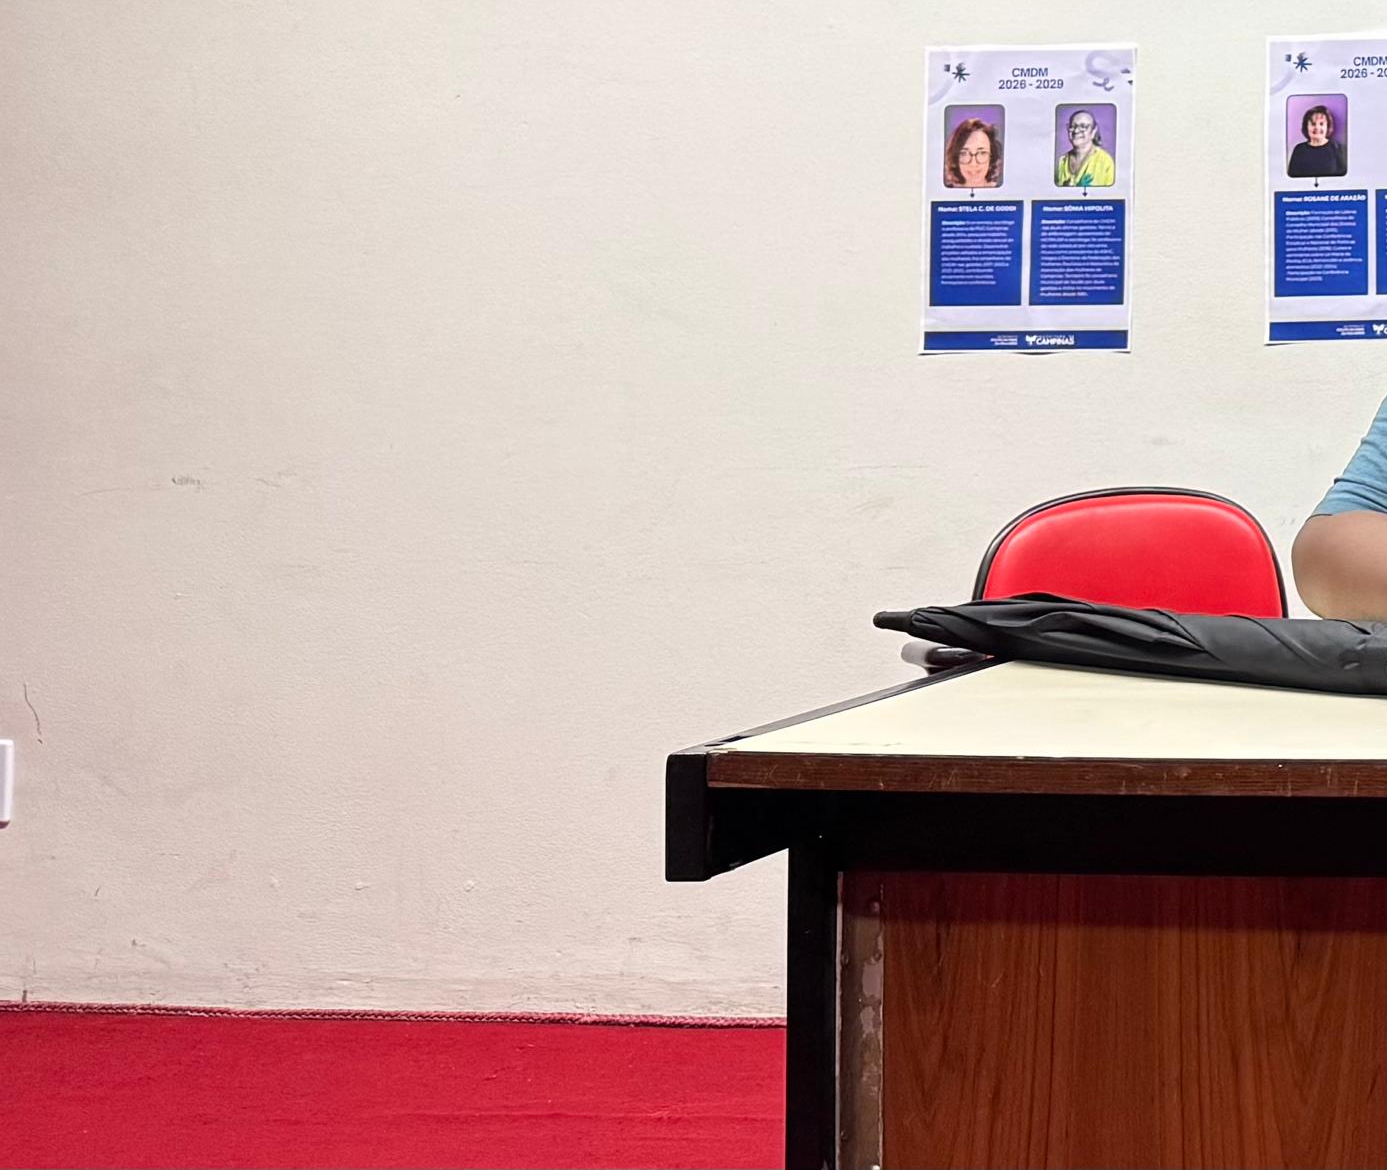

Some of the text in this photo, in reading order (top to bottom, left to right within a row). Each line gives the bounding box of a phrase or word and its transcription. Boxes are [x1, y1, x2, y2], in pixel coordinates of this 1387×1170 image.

[1012, 67, 1048, 77] CMDM
[1340, 68, 1368, 79] 2026
[998, 79, 1026, 90] 2026
[1035, 79, 1064, 89] 2029
[1036, 337, 1074, 345] CAMPINAS
